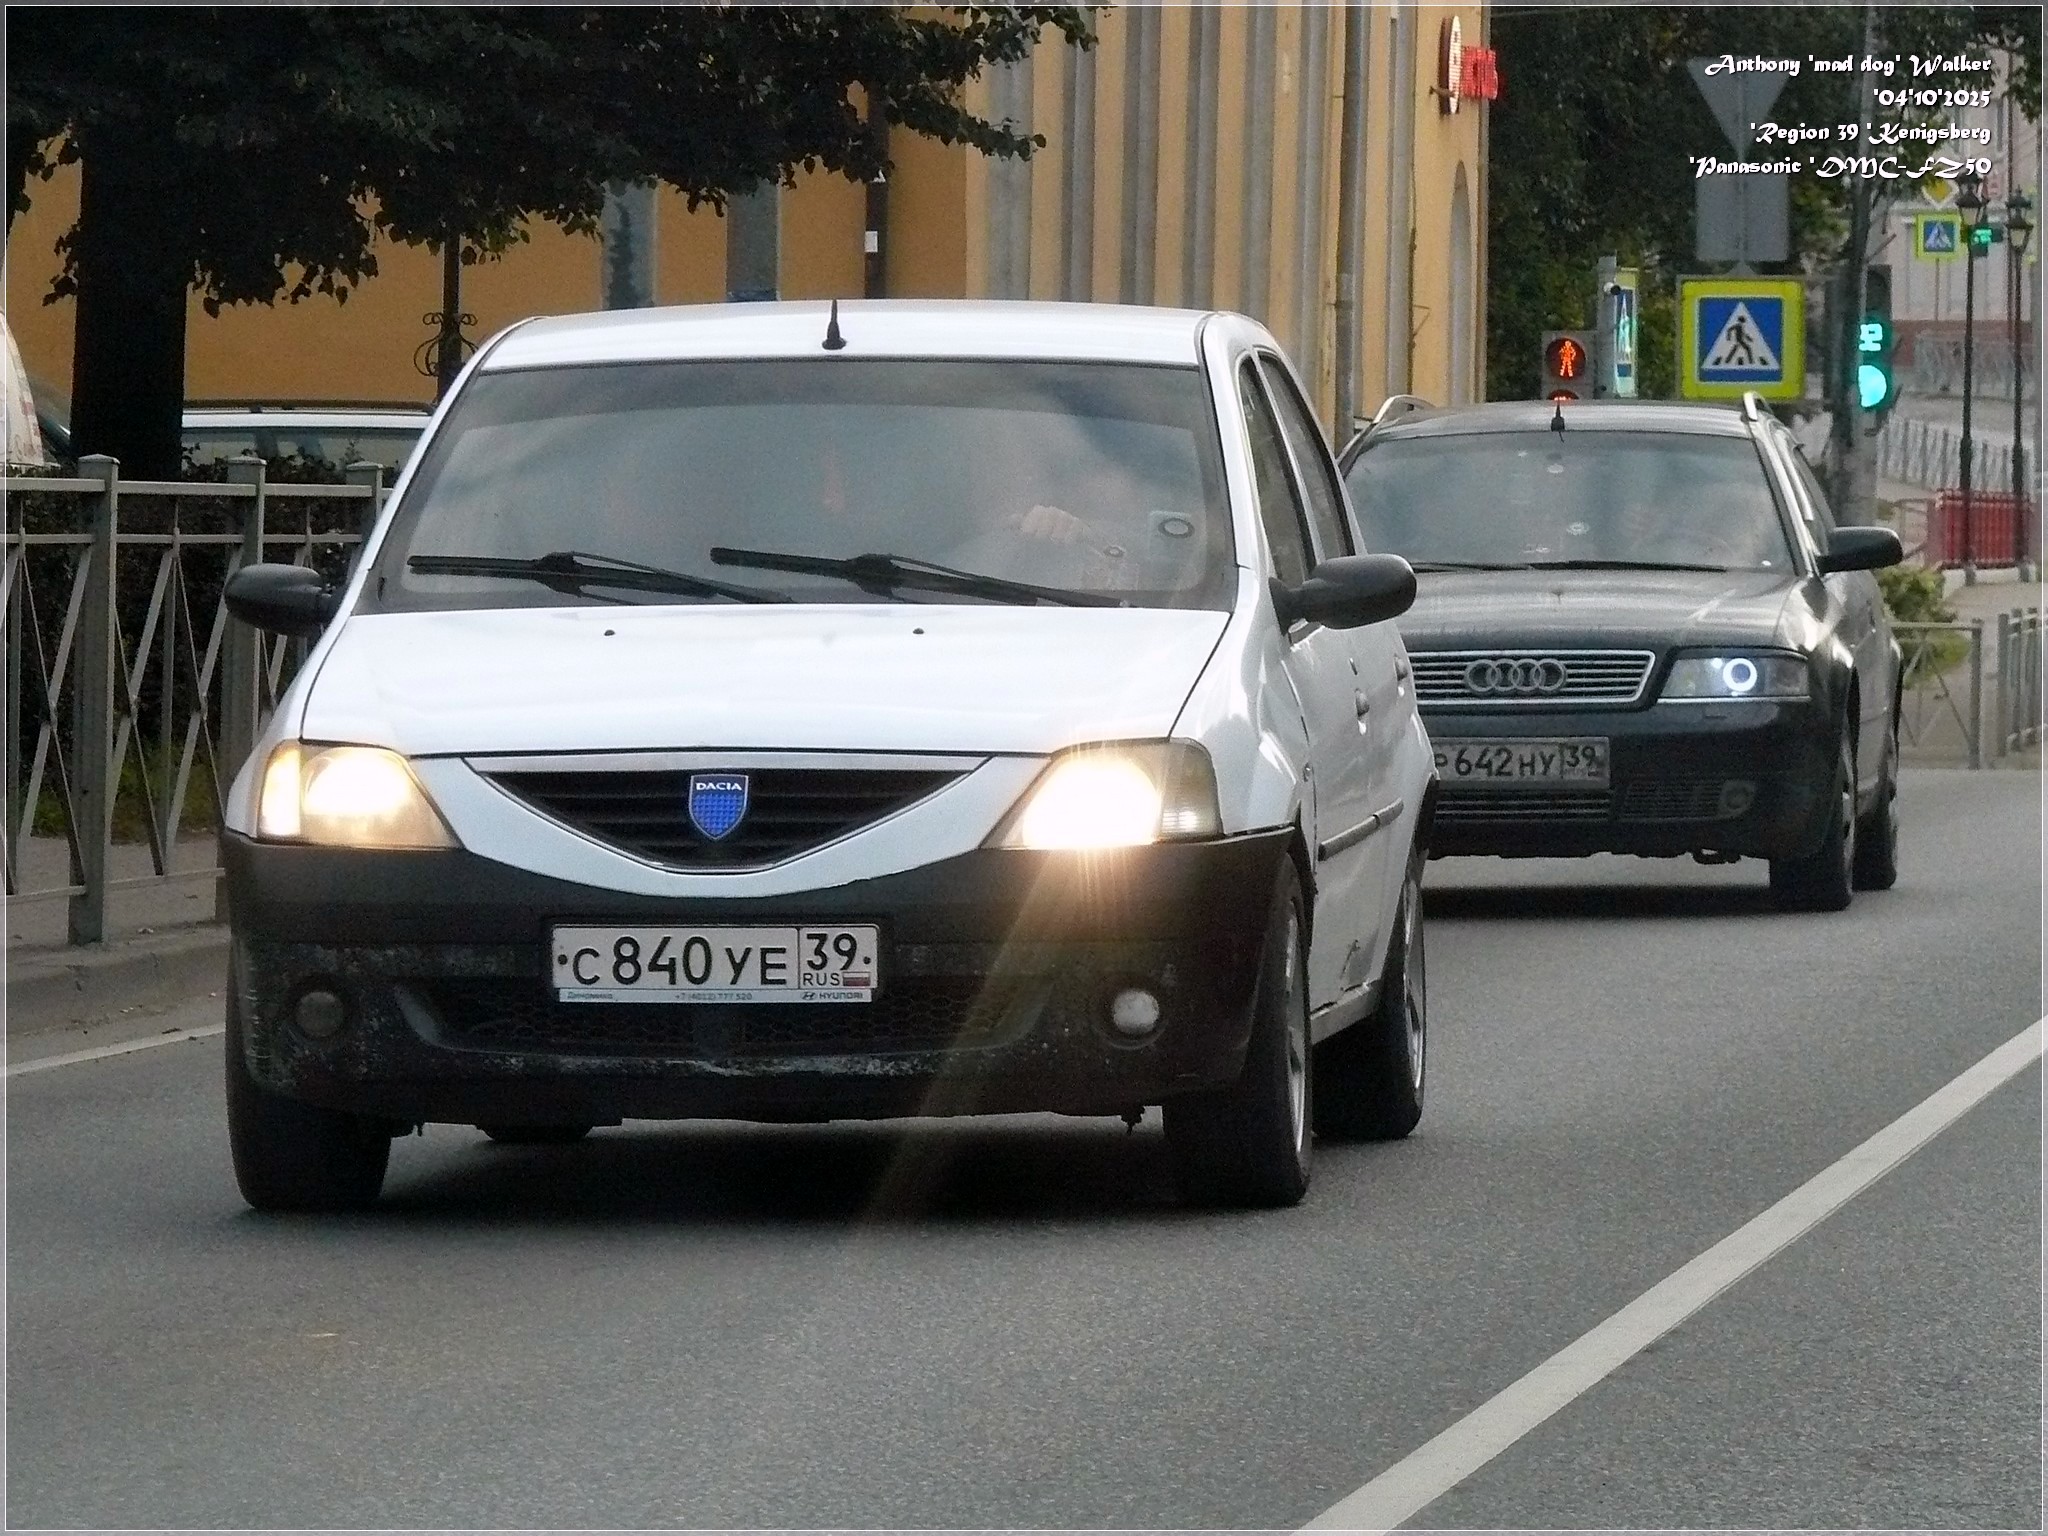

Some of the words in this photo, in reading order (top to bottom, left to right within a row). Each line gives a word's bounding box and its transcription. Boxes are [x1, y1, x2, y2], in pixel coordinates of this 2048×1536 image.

[695, 782, 743, 791] DACIA
[806, 933, 857, 971] 39
[803, 972, 841, 986] RUS
[818, 992, 864, 1000] HYUNDAI
